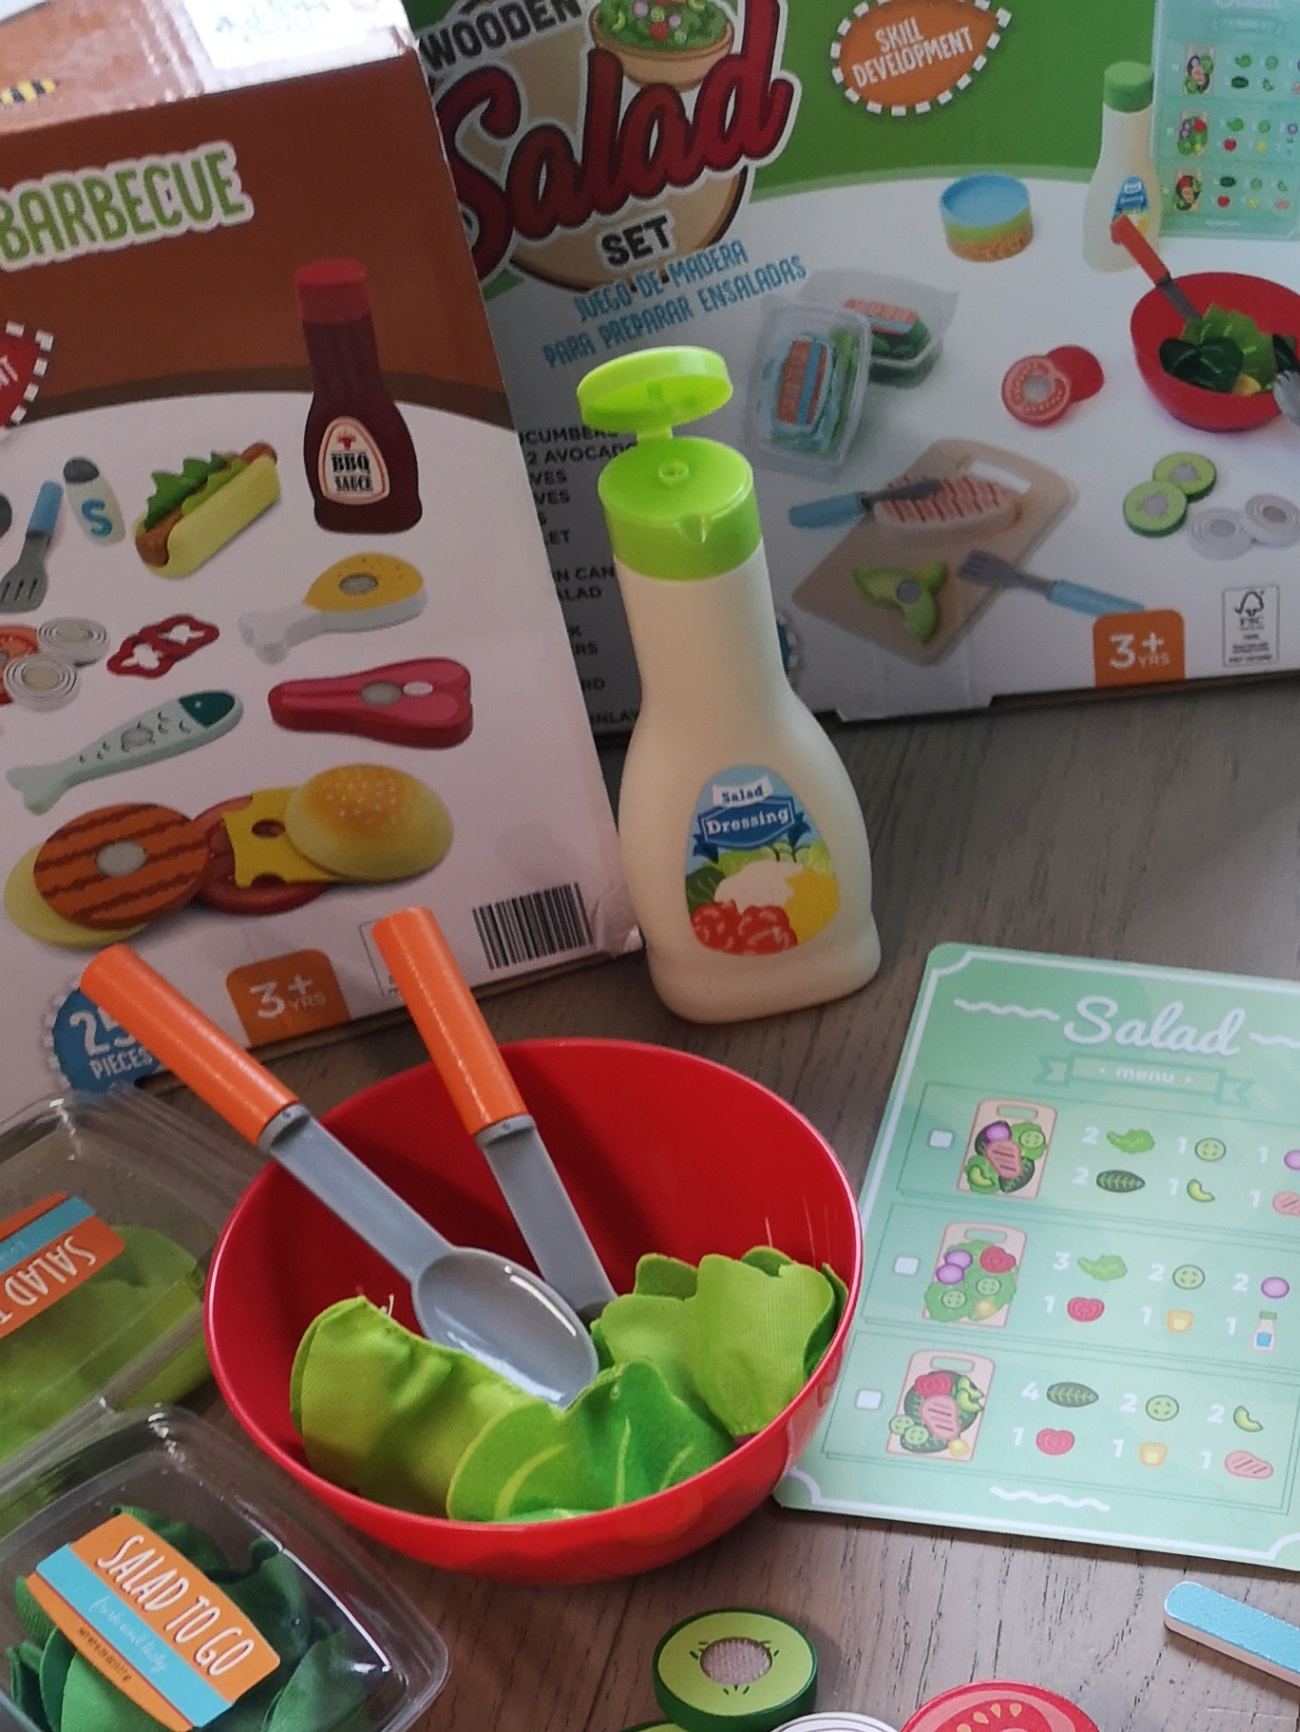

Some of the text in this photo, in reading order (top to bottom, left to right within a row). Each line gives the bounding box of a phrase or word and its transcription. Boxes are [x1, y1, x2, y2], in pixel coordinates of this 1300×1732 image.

[875, 16, 924, 53] SKILL
[852, 27, 973, 88] DEVELOPMENT
[435, 0, 794, 283] Salad
[0, 151, 246, 261] BARBECUE
[601, 215, 671, 267] SET
[573, 239, 749, 323] JUEGO DE MADERA
[542, 332, 596, 368] PARA
[598, 295, 695, 349] PREPARAR
[698, 254, 807, 313] ENSALADAS
[331, 451, 371, 474] BBQ
[526, 451, 538, 465] 2
[81, 500, 113, 537] S
[721, 785, 764, 804] Salad
[705, 807, 790, 835] Dressing
[1064, 995, 1246, 1057] Salad
[89, 1046, 154, 1080] PIECES
[1116, 1067, 1175, 1084] menu
[1081, 1127, 1269, 1164] 2 1 1
[1072, 1167, 1261, 1208] 2 1 1
[4, 1235, 97, 1307] SALAD
[1053, 1252, 1249, 1292] 3 2 2
[1045, 1295, 1237, 1336] 1 1 1
[1021, 1382, 1225, 1424] 4 2 2
[1013, 1427, 1212, 1469] 1 1 1
[97, 1534, 255, 1677] SALAD TO GO
